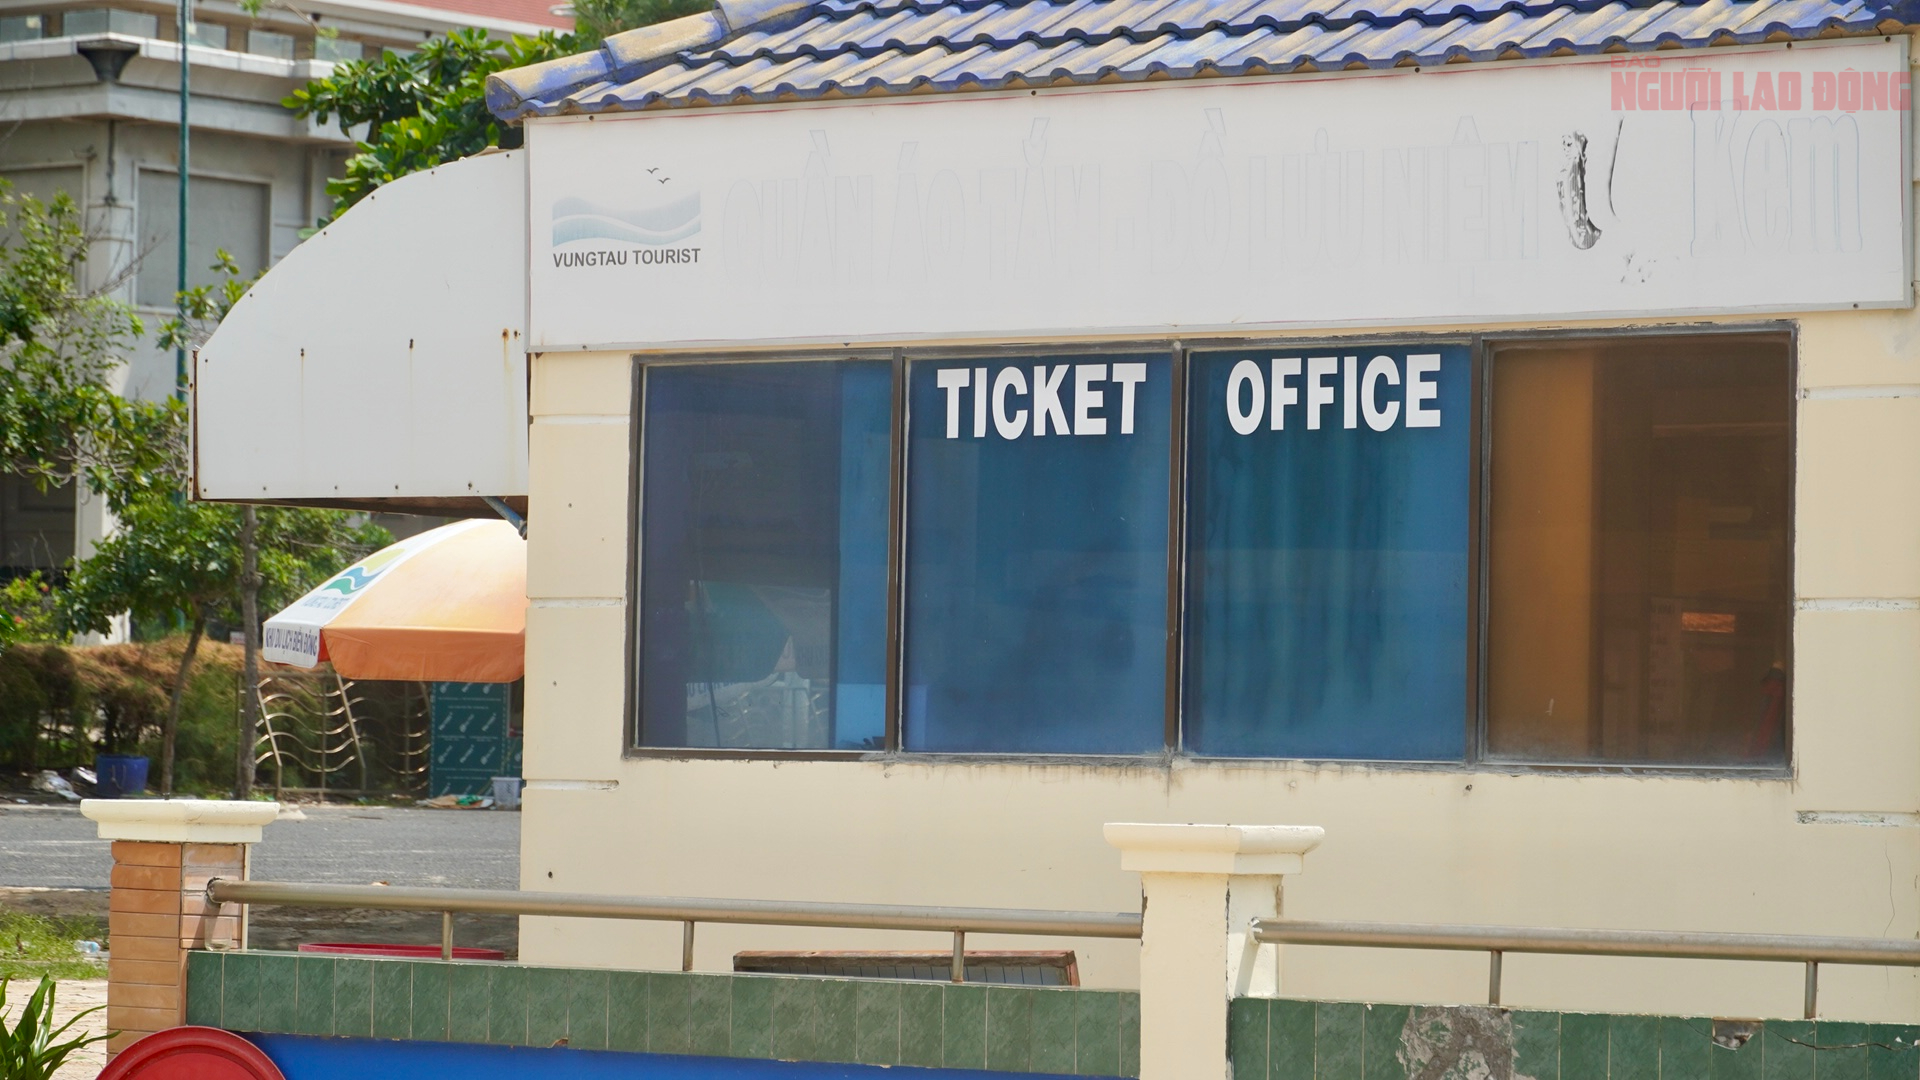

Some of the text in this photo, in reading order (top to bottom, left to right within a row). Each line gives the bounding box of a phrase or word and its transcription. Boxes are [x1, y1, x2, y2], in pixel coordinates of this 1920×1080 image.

[1691, 99, 1863, 258] Kem
[553, 248, 701, 267] VUNGTAU TOURIST
[937, 354, 1442, 440] TICKET OFFICE
